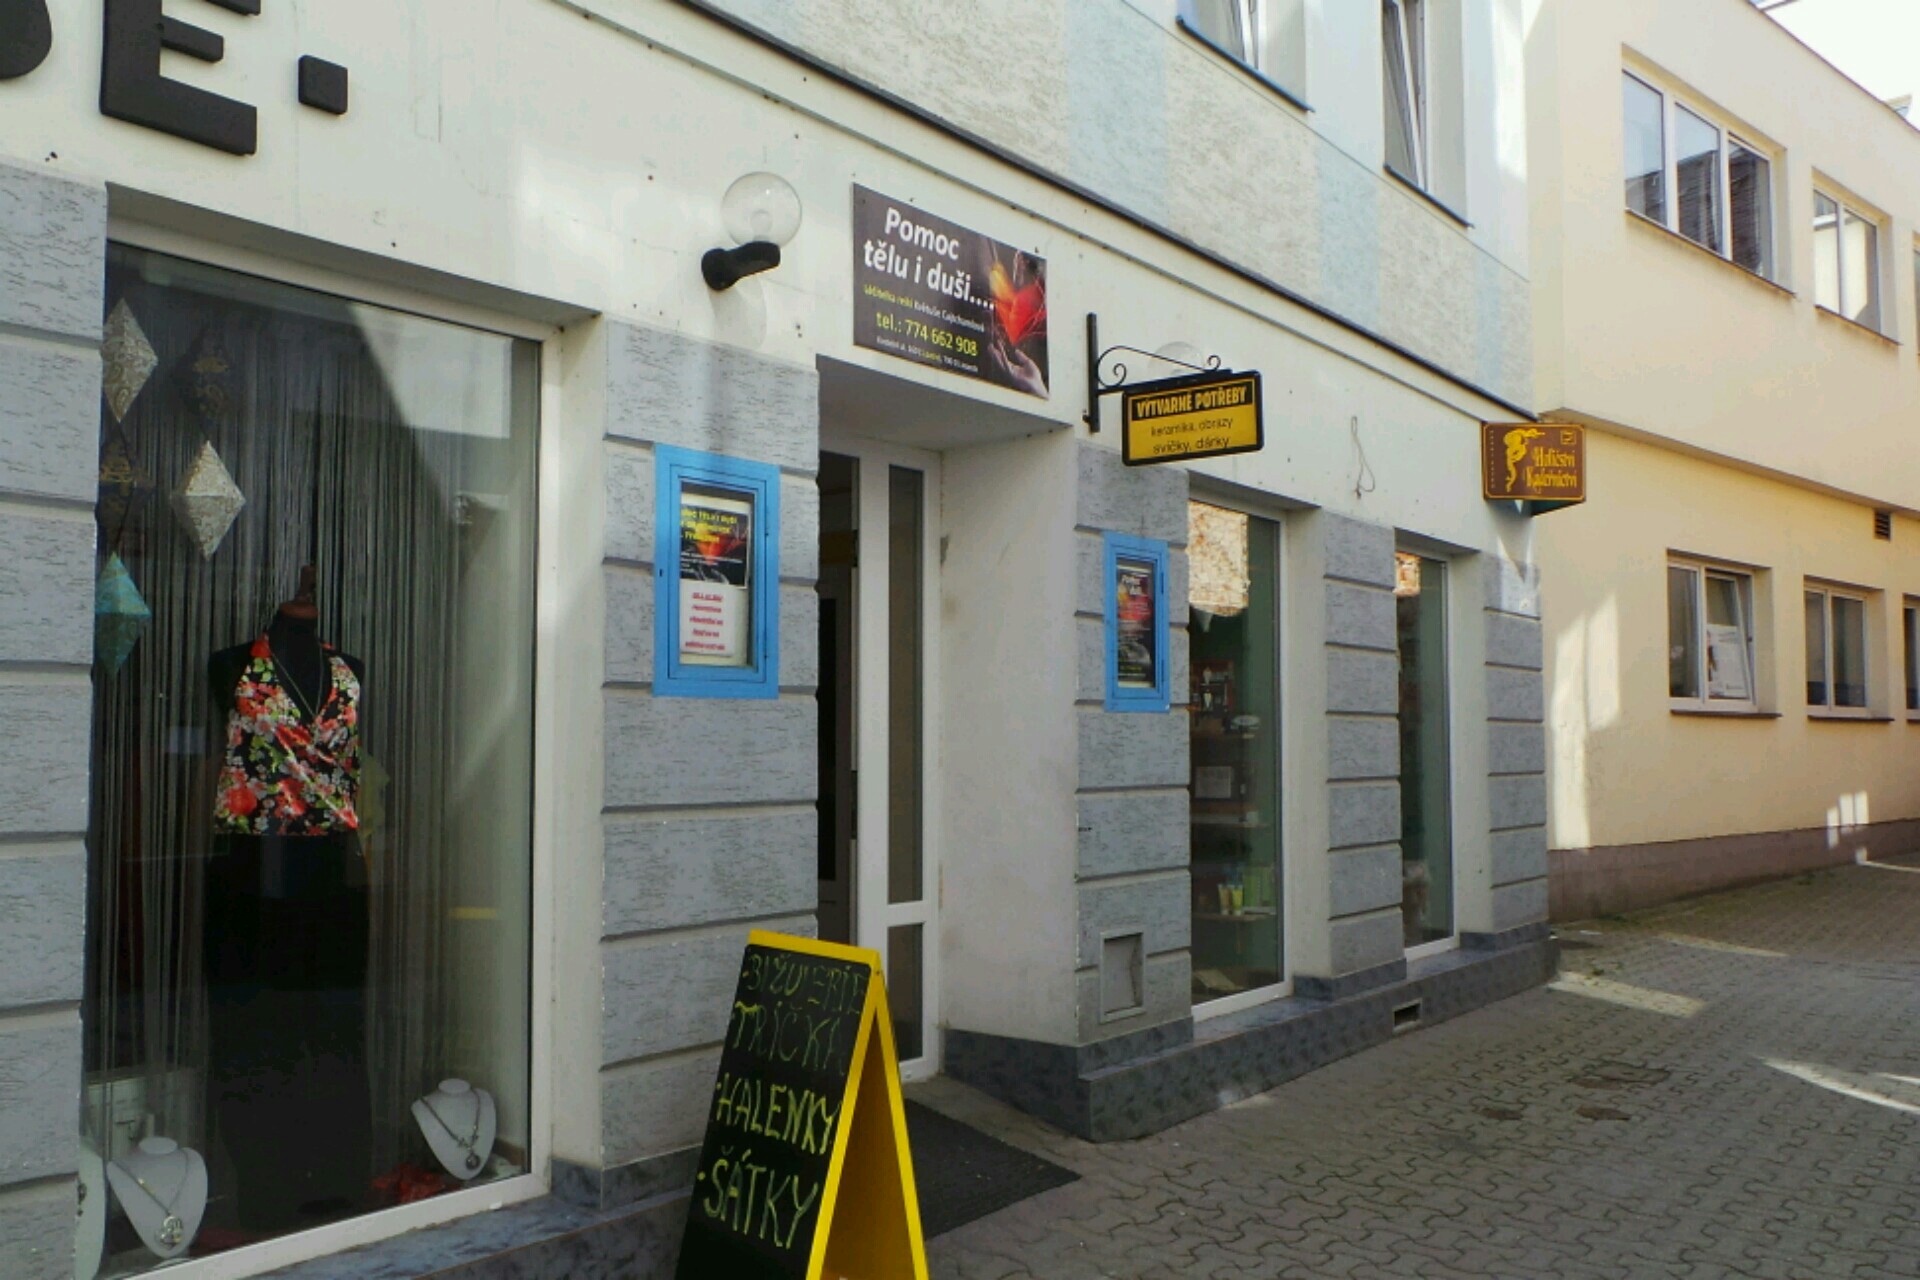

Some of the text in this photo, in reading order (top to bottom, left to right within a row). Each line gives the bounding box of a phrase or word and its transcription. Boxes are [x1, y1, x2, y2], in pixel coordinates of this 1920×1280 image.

[885, 207, 960, 261] Pomoc
[864, 239, 909, 280] tělu
[914, 255, 922, 284] i
[876, 312, 902, 329] tel.:
[905, 319, 929, 341] 774
[931, 329, 953, 349] 662
[955, 336, 979, 357] 908
[1137, 385, 1247, 418] VÝTVARNÉ POTŘEBY
[1195, 437, 1230, 450] dárky
[1198, 418, 1233, 432] obrazy
[716, 1072, 843, 1156] HALENKY
[703, 1144, 819, 1250] ŠÁTKY
